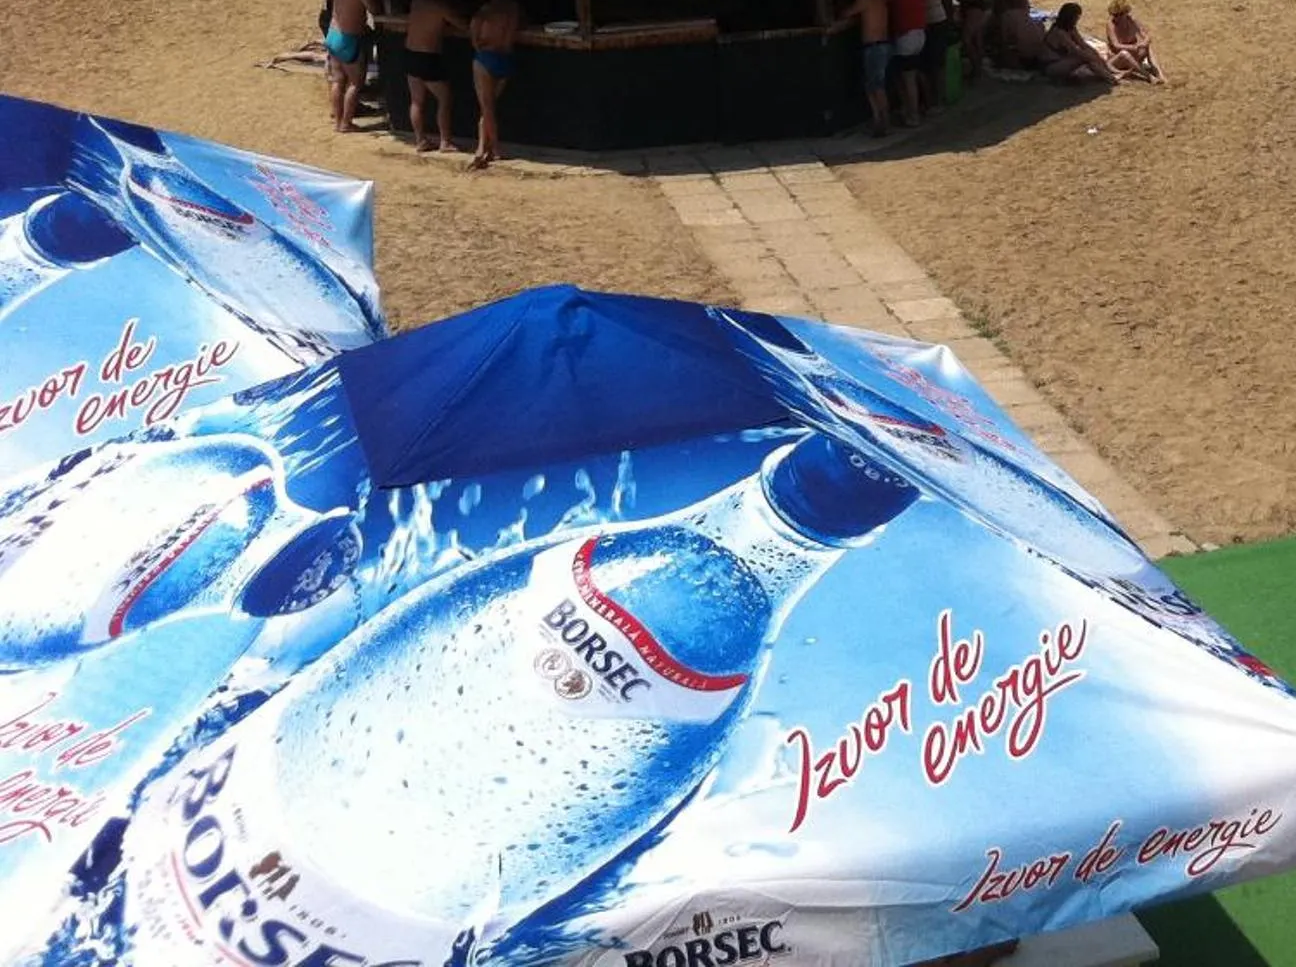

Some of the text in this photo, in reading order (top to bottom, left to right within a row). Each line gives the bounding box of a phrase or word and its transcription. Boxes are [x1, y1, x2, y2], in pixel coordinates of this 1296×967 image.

[0, 320, 155, 432] zvor de
[76, 340, 241, 434] energie
[542, 598, 652, 704] BORSEC
[923, 618, 1087, 785] energie
[787, 612, 982, 834] Izvor de
[182, 743, 422, 967] BORS
[953, 808, 1283, 913] Izvor de energie
[624, 920, 786, 967] BORSEC
